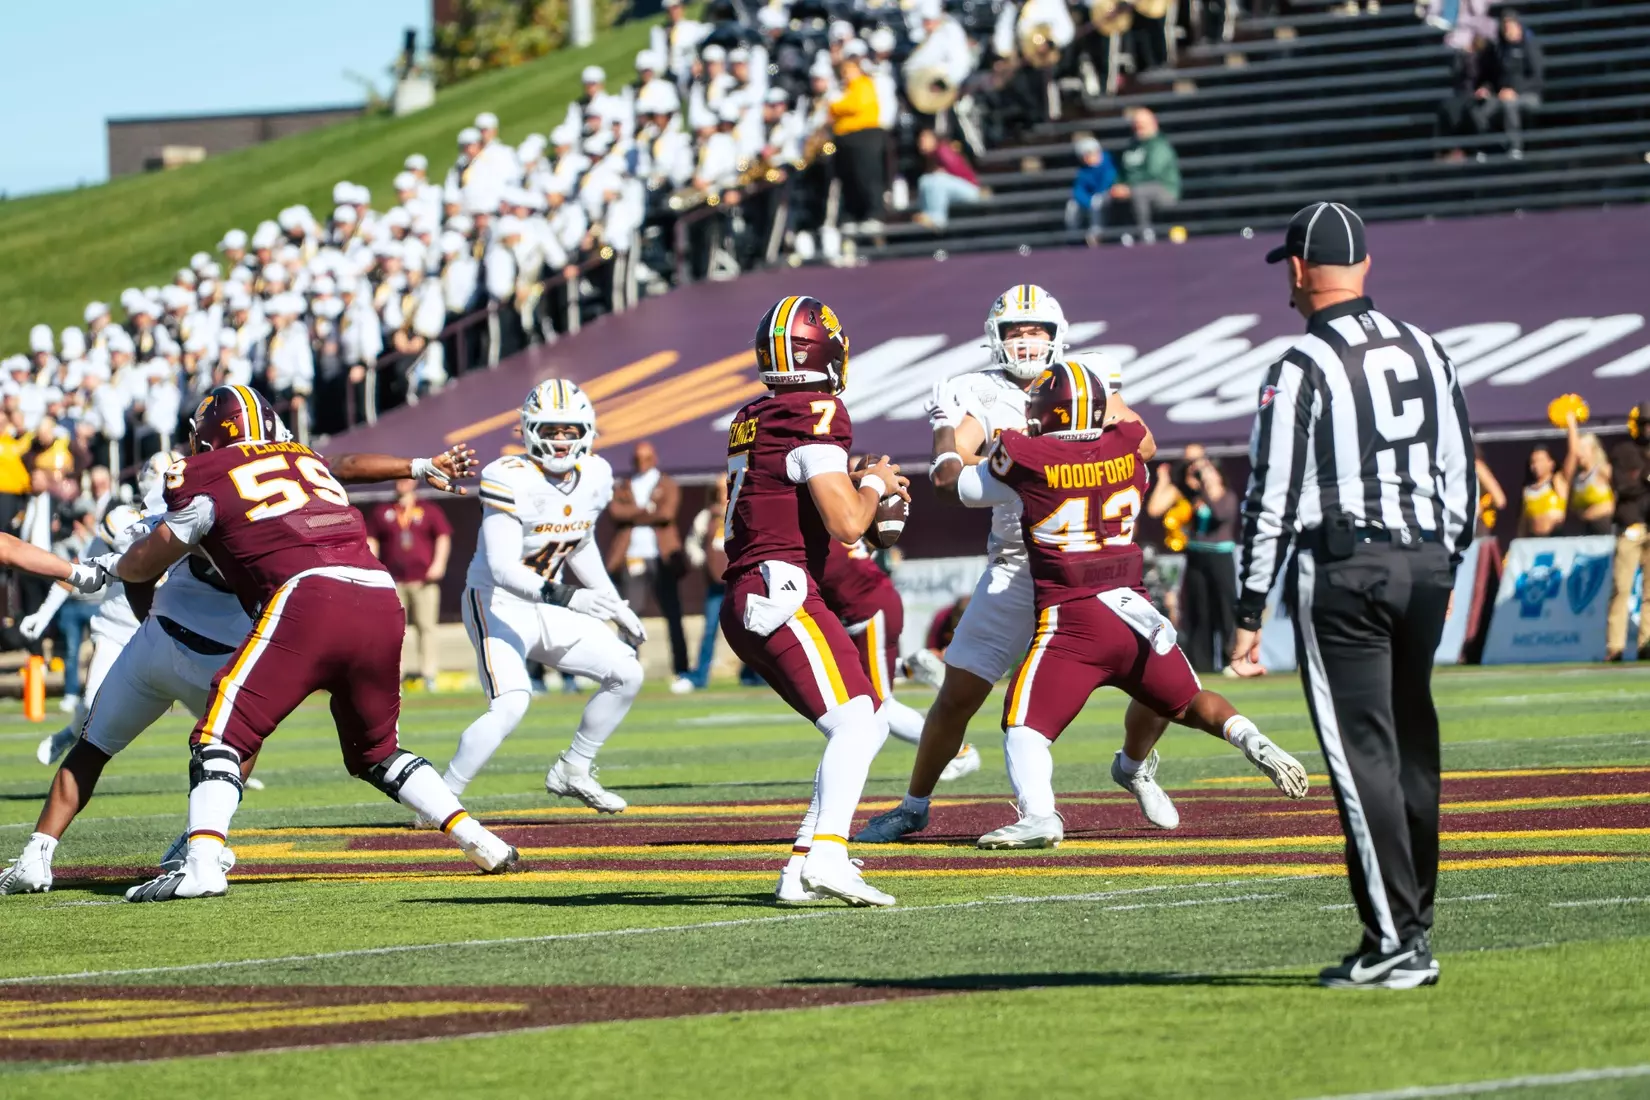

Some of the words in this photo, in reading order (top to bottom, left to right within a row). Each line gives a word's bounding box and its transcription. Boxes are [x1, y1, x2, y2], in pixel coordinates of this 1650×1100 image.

[765, 374, 806, 383] RESPECT
[1363, 345, 1425, 442] C
[809, 400, 837, 435] 7
[1058, 432, 1097, 441] HONESTY
[228, 454, 349, 522] 59
[1044, 454, 1135, 489] WOODFORD
[533, 519, 592, 533] BRONCOS
[1030, 485, 1141, 552] 43
